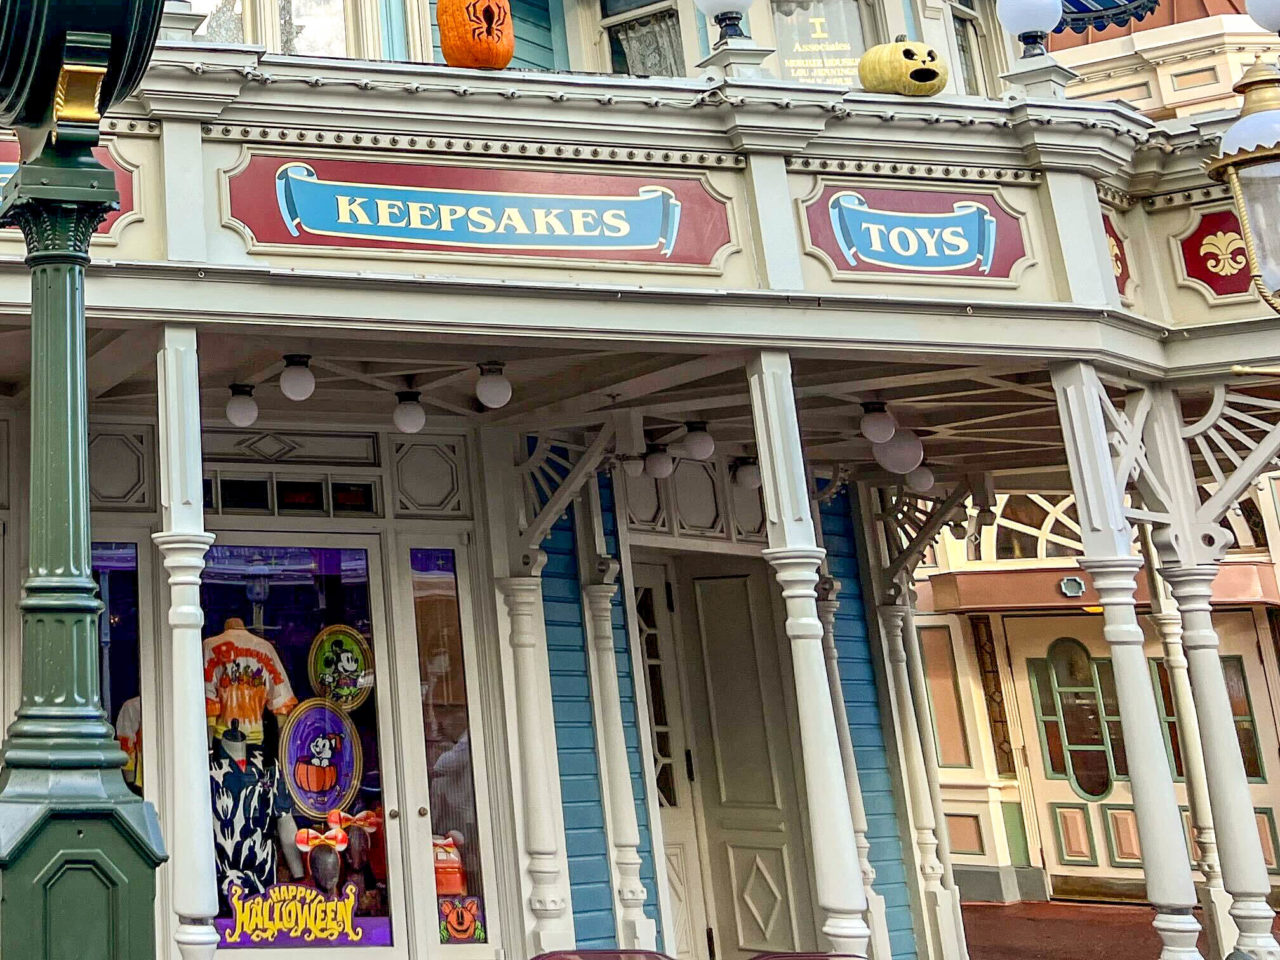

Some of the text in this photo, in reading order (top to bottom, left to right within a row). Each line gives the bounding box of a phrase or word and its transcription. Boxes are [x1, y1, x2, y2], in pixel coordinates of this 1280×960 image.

[335, 195, 631, 237] KEEPSAKES
[861, 222, 969, 257] TOYS
[270, 885, 318, 903] HAPPY
[225, 884, 362, 943] HALLOWEEN
